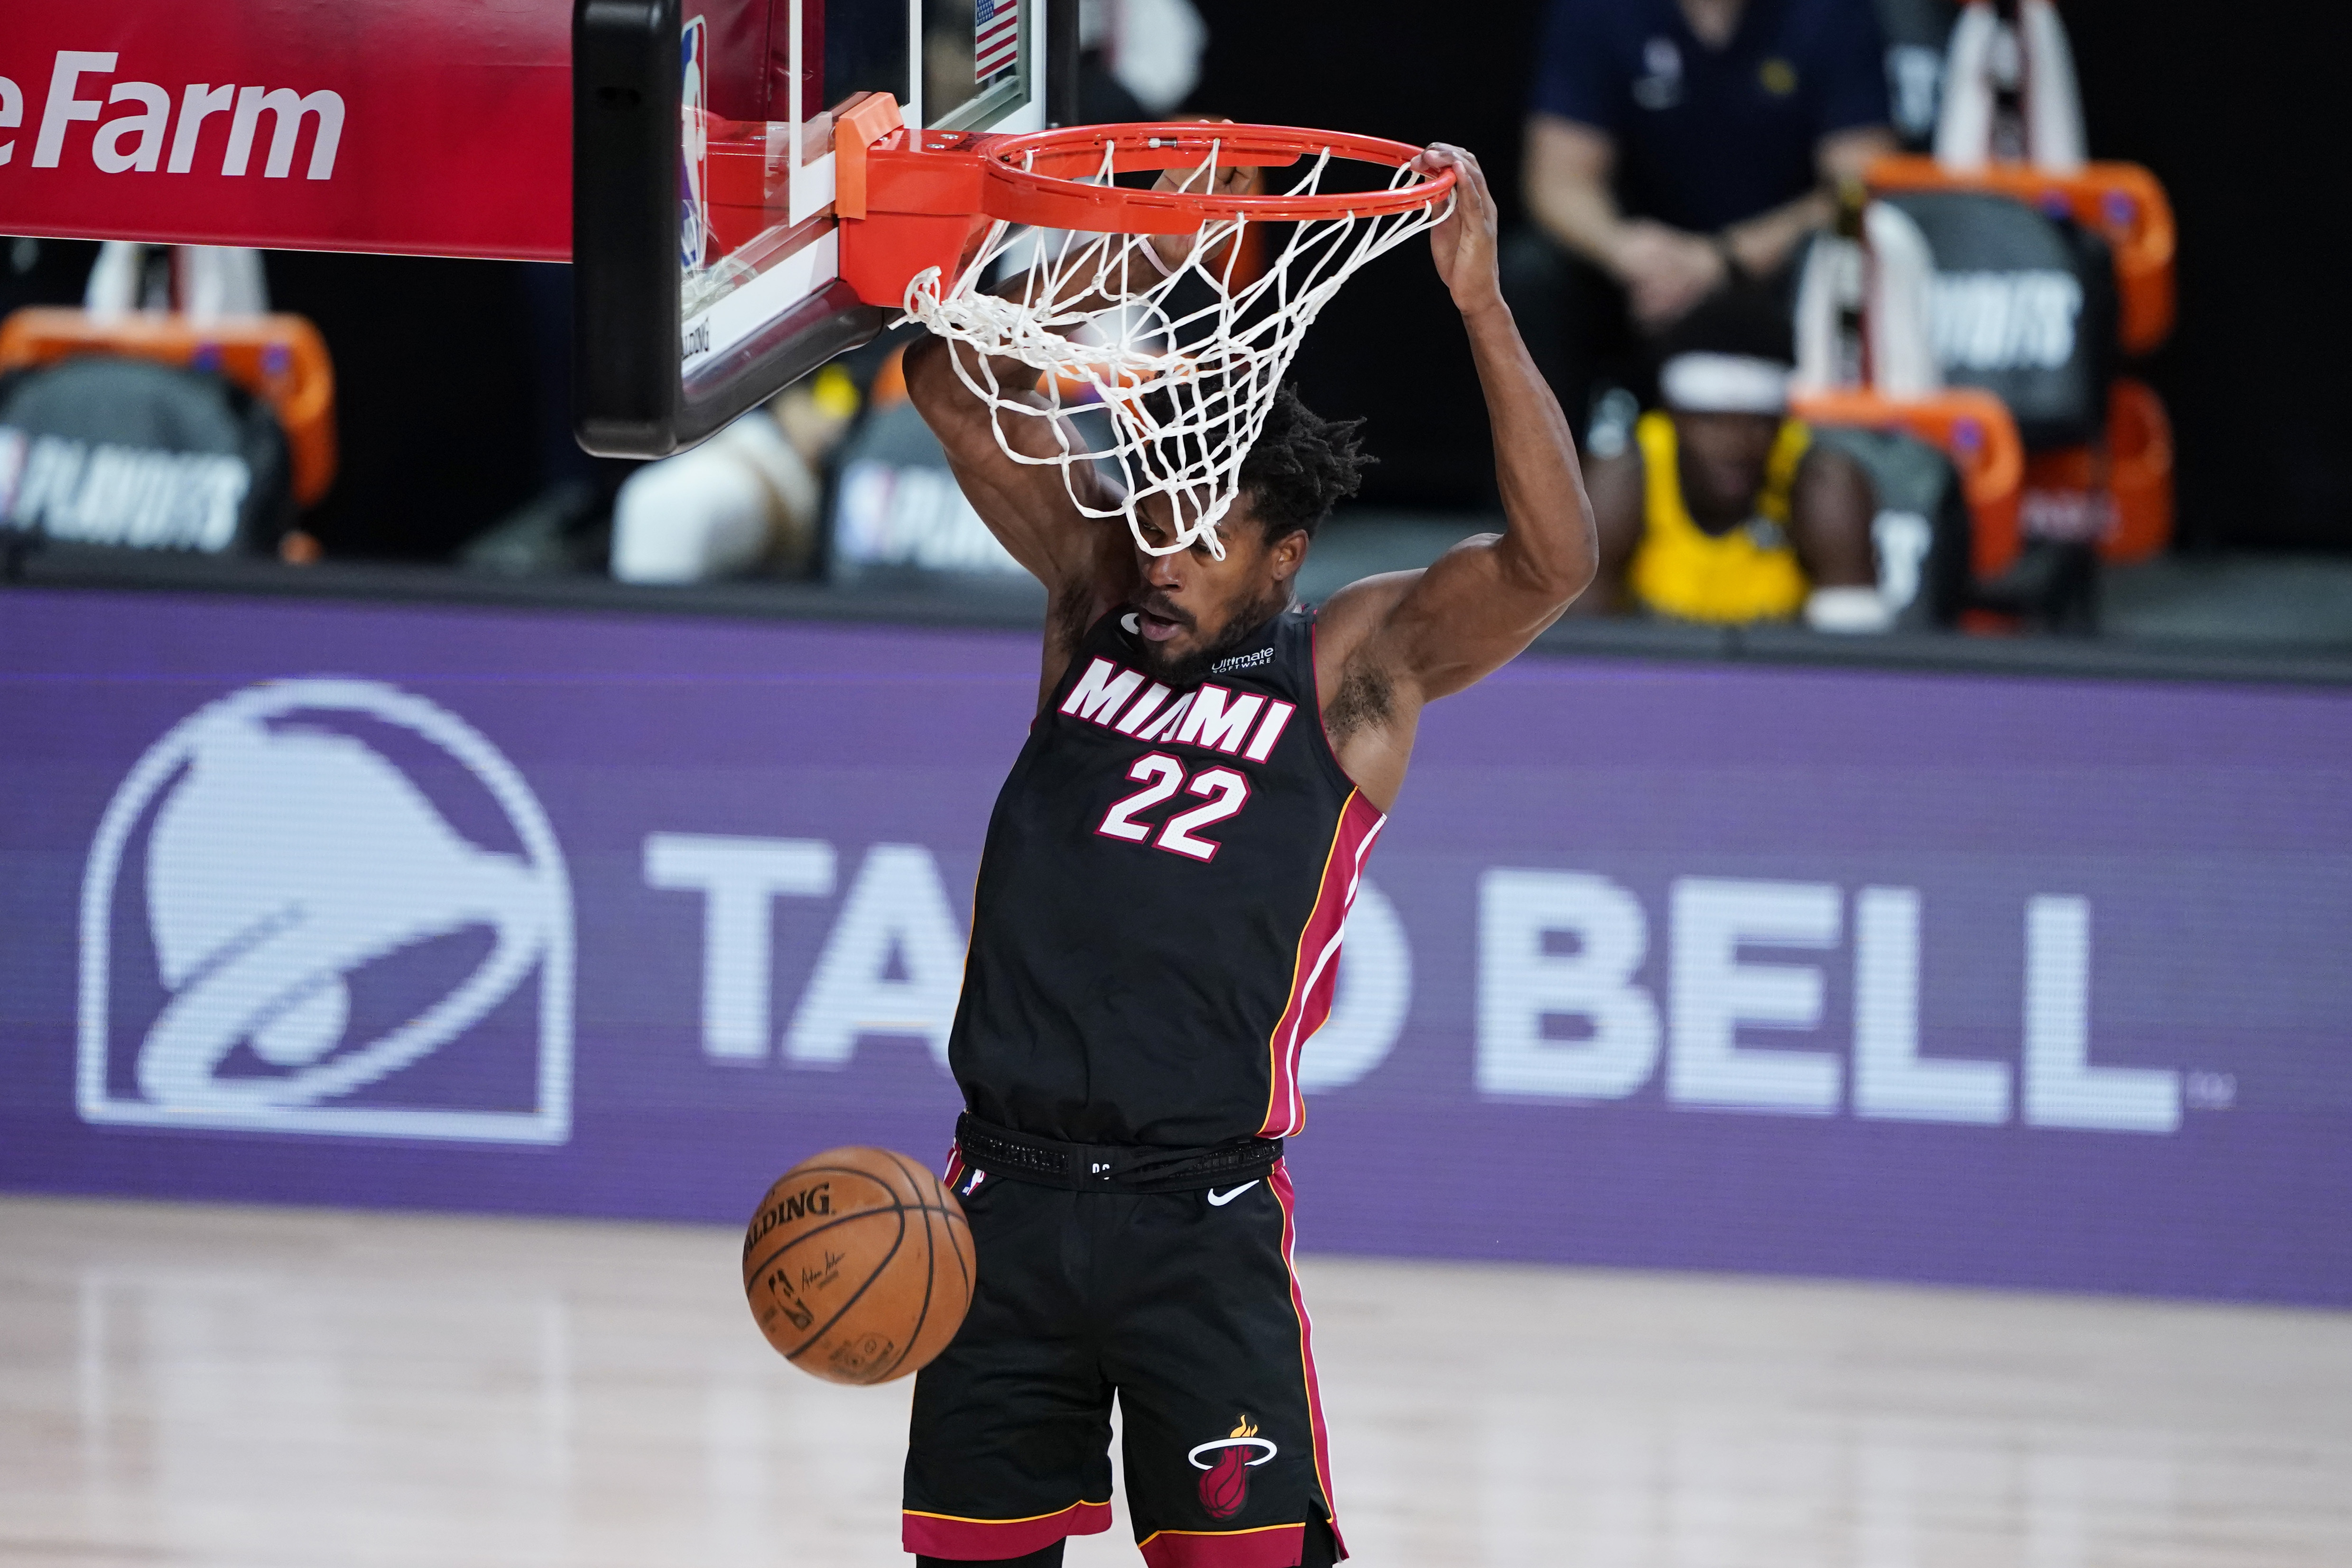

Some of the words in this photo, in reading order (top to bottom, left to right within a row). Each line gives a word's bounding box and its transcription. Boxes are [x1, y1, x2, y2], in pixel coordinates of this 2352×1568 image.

[31, 50, 346, 180] Farm
[1060, 656, 1296, 764] MIAMI
[1211, 647, 1274, 671] Ultimate
[1213, 657, 1271, 674] SOFTWARE
[1095, 751, 1251, 863] 22
[641, 830, 1414, 1095] TA
[1472, 865, 2185, 1134] BELL
[743, 1182, 830, 1262] ALDING
